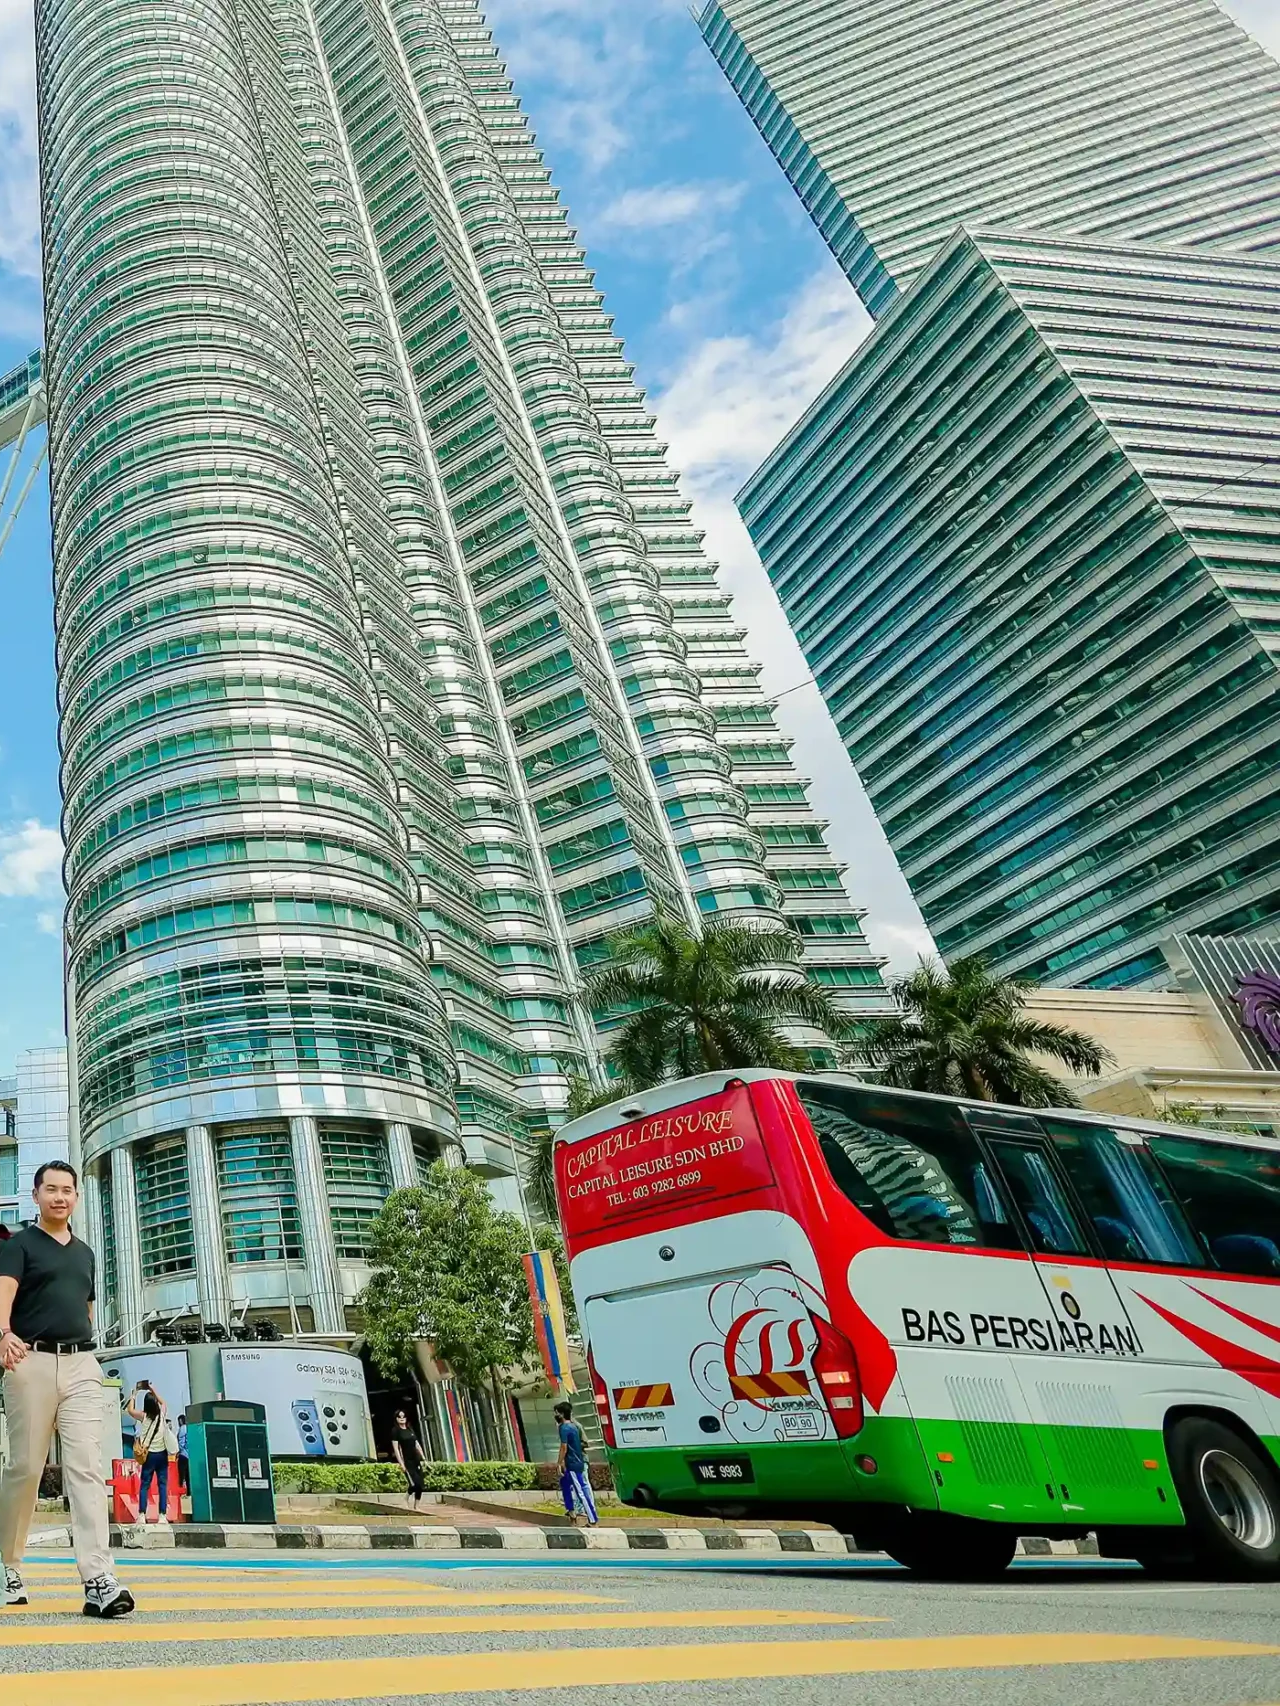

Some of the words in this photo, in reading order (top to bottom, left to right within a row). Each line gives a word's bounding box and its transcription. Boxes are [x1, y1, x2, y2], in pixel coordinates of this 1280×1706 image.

[567, 1130, 637, 1178] CAPITAL
[639, 1110, 734, 1144] LEISURE
[568, 1172, 618, 1199] CAPITAL
[619, 1155, 674, 1183] LEISURE
[675, 1146, 707, 1168] SDN
[708, 1136, 745, 1158] BHD
[632, 1184, 650, 1200] 603
[651, 1177, 676, 1195] 9282
[676, 1170, 702, 1187] 6899
[901, 1307, 966, 1345] BAS
[970, 1313, 1139, 1357] PERSIARAN
[226, 1353, 261, 1361] SAMSUNG
[296, 1363, 324, 1376] Galaxy
[324, 1365, 336, 1375] S24
[784, 1417, 797, 1428] 80
[800, 1418, 812, 1428] 90
[699, 1465, 717, 1479] VAE
[719, 1464, 743, 1478] 9983
